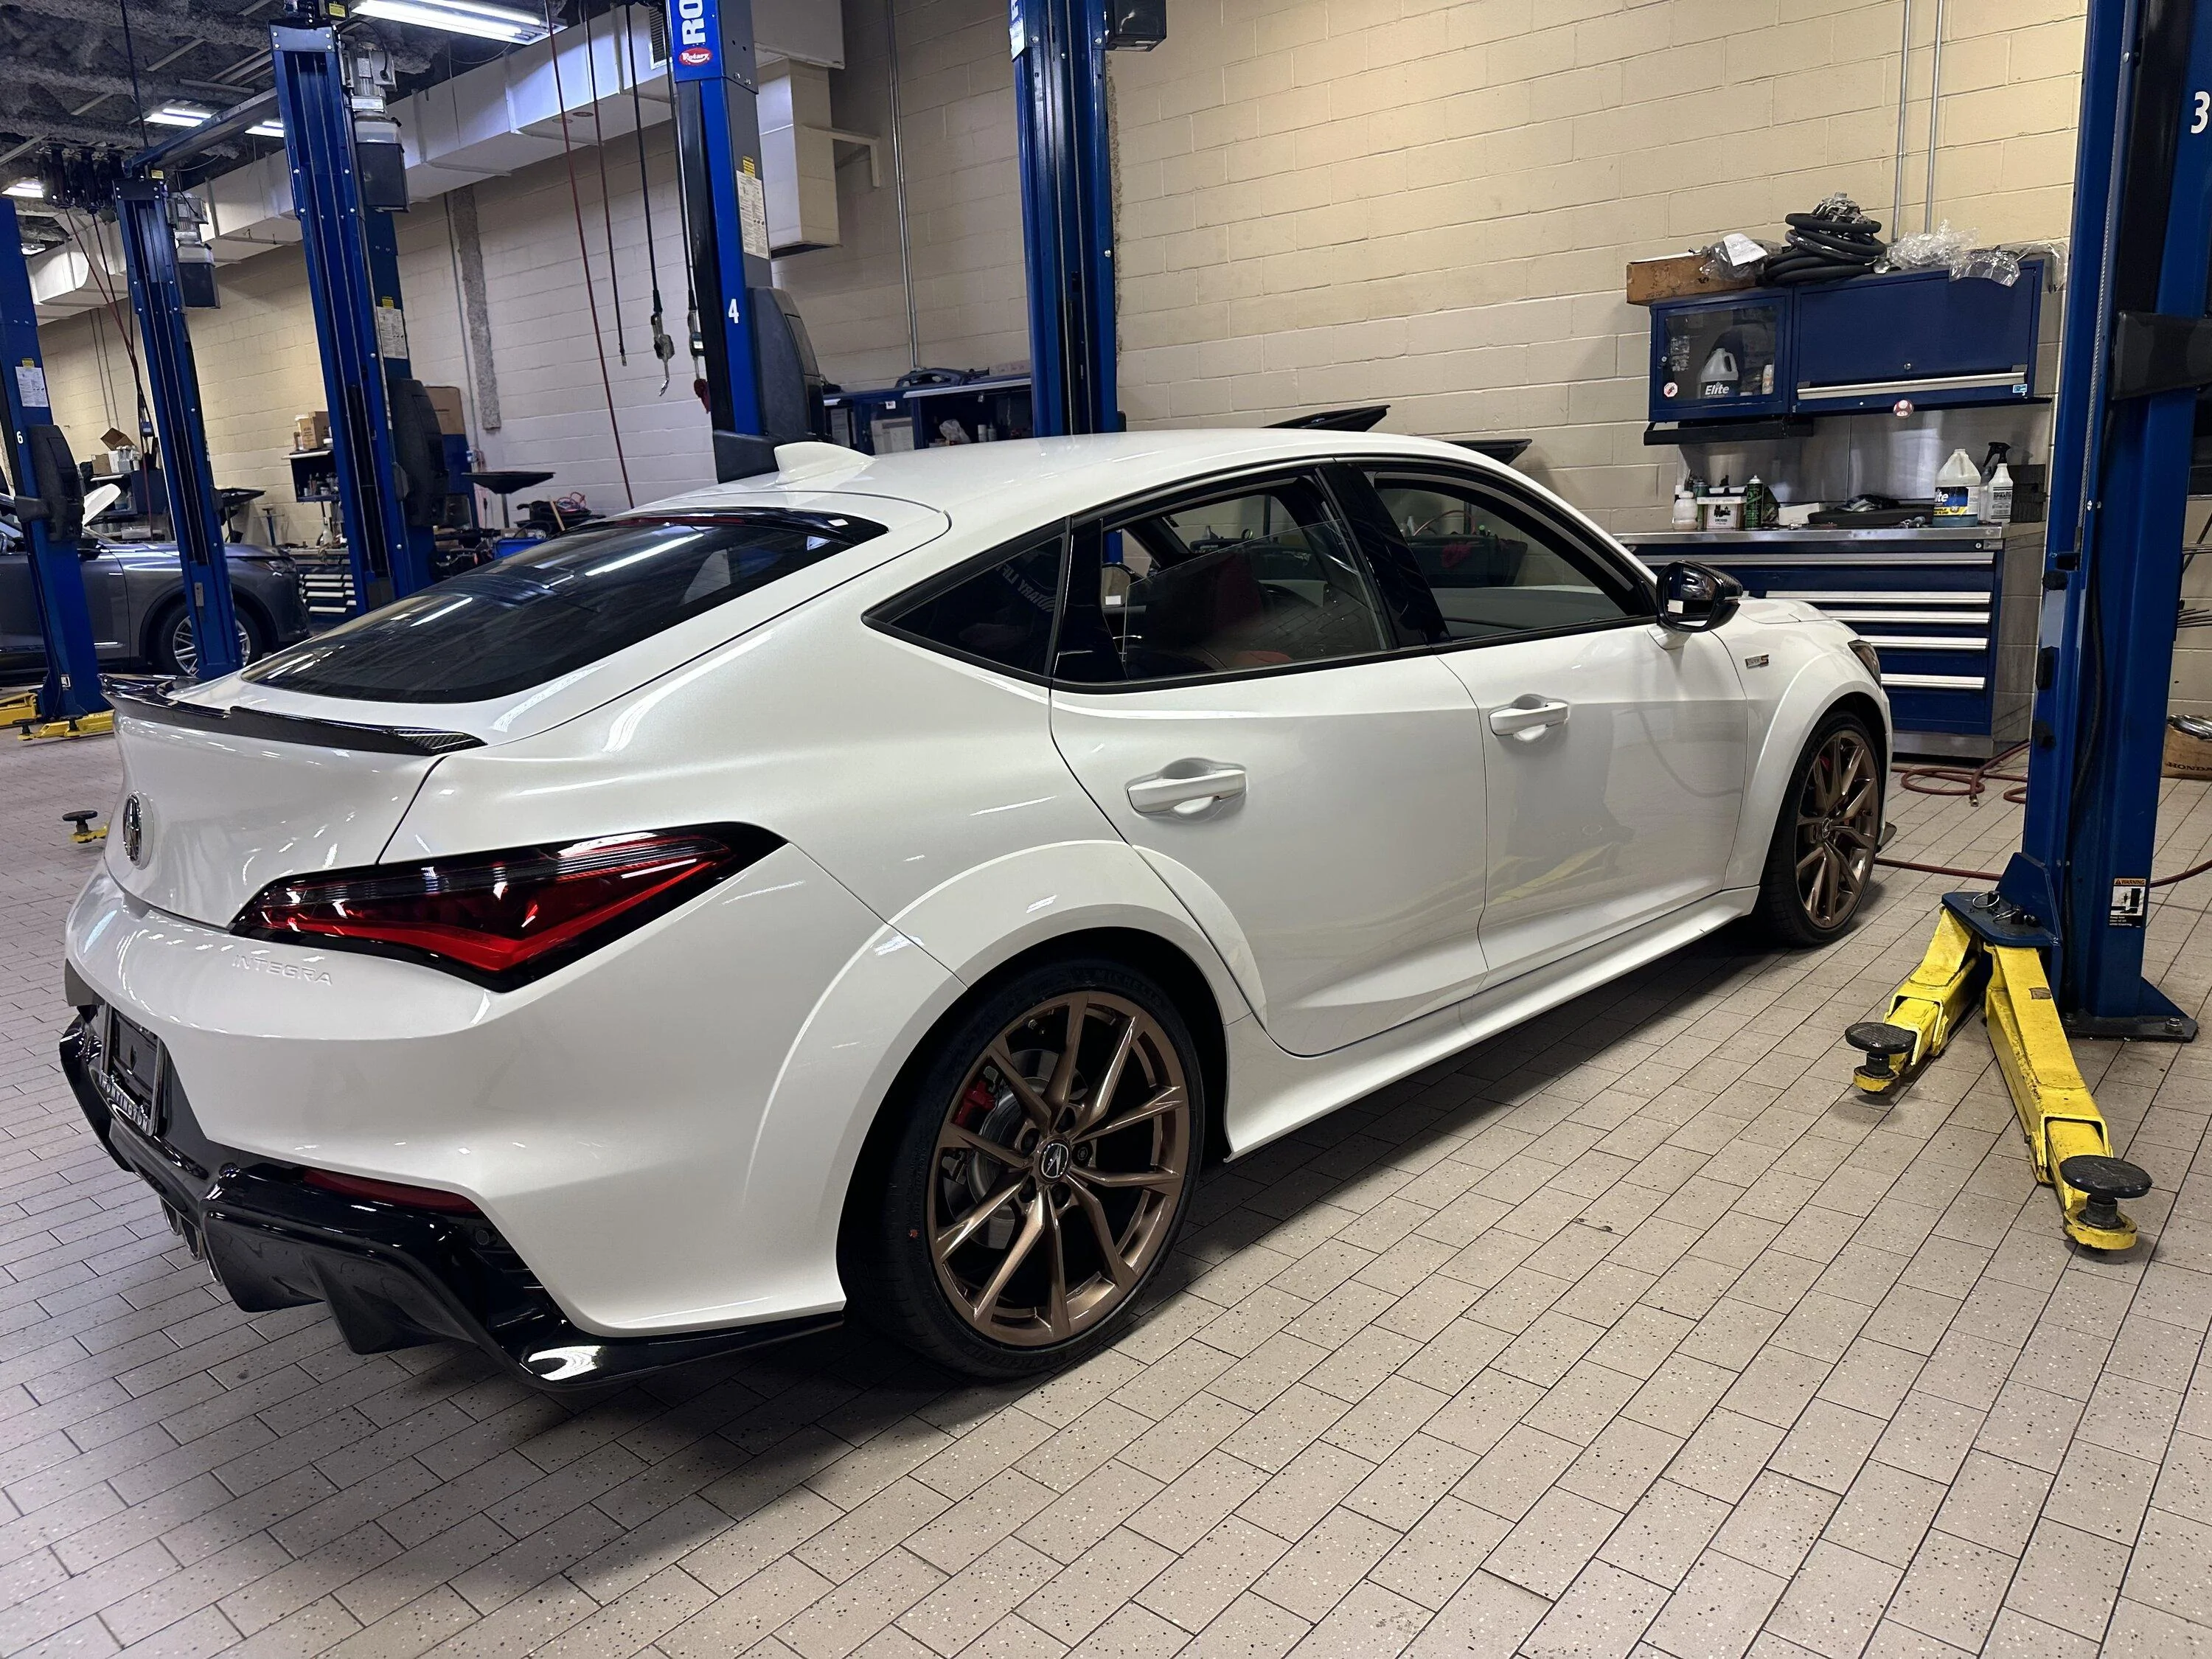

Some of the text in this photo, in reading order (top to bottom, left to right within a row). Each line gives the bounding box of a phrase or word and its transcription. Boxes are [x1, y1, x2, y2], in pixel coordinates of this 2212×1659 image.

[2191, 91, 2211, 133] 3
[728, 299, 740, 324] 4
[1705, 383, 1730, 395] Elite
[16, 431, 24, 444] 6
[232, 953, 333, 987] INTEGRA
